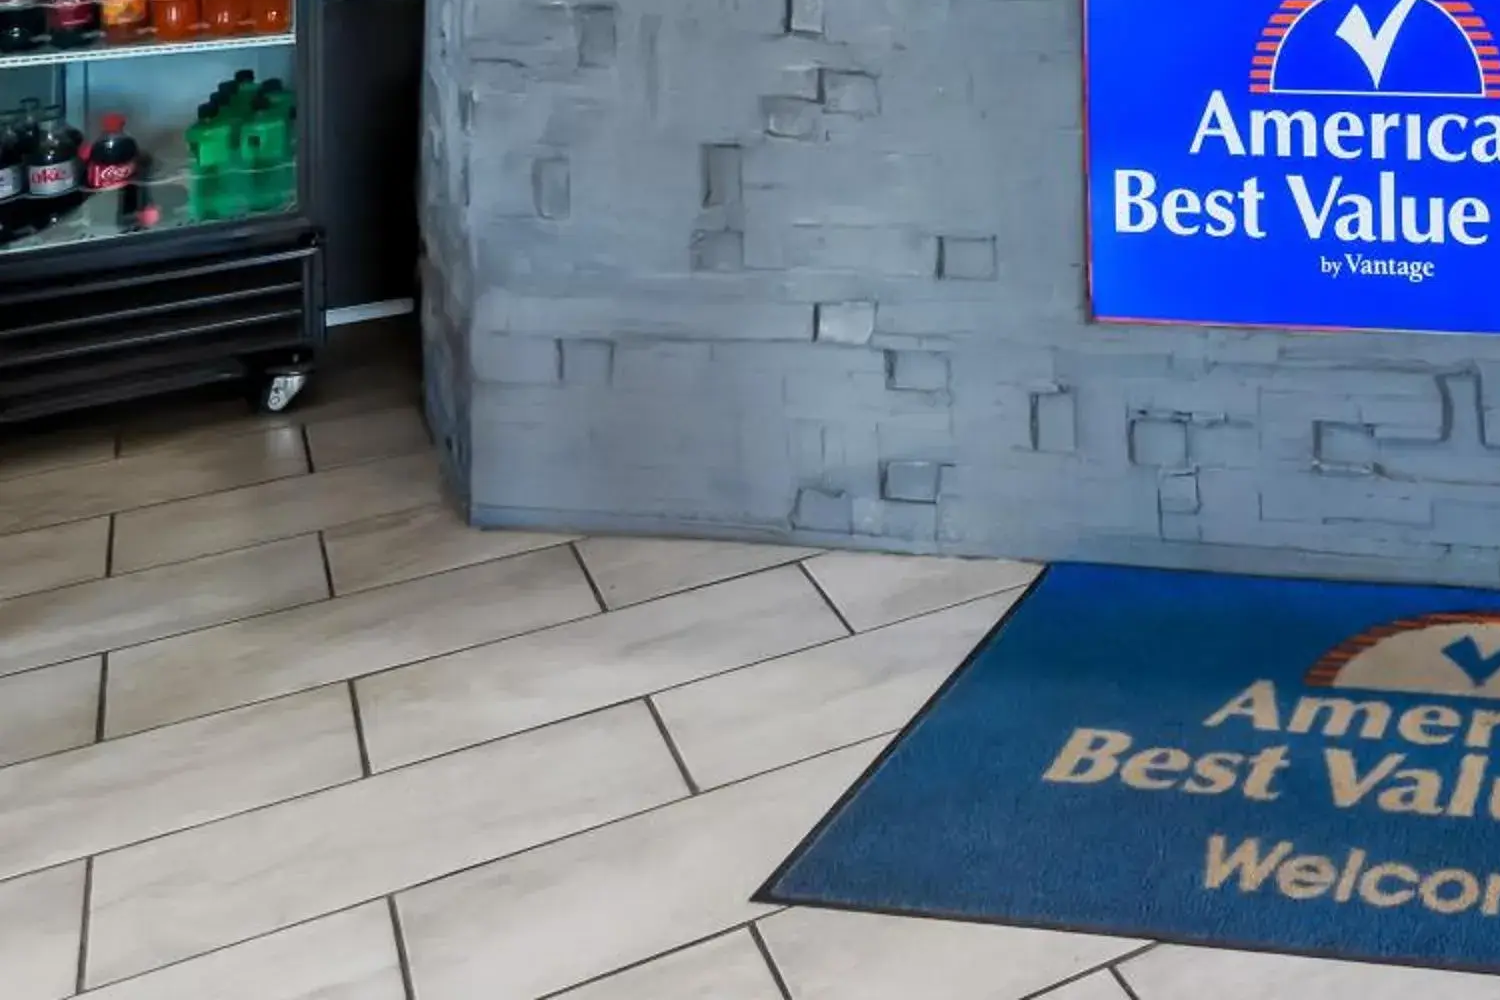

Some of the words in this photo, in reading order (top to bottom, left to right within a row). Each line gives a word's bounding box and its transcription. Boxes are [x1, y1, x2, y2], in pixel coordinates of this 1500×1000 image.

[1114, 169, 1266, 239] Best
[1285, 171, 1490, 245] Value
[1320, 255, 1342, 281] by
[1345, 253, 1435, 283] Vantage
[1042, 727, 1289, 800] Best
